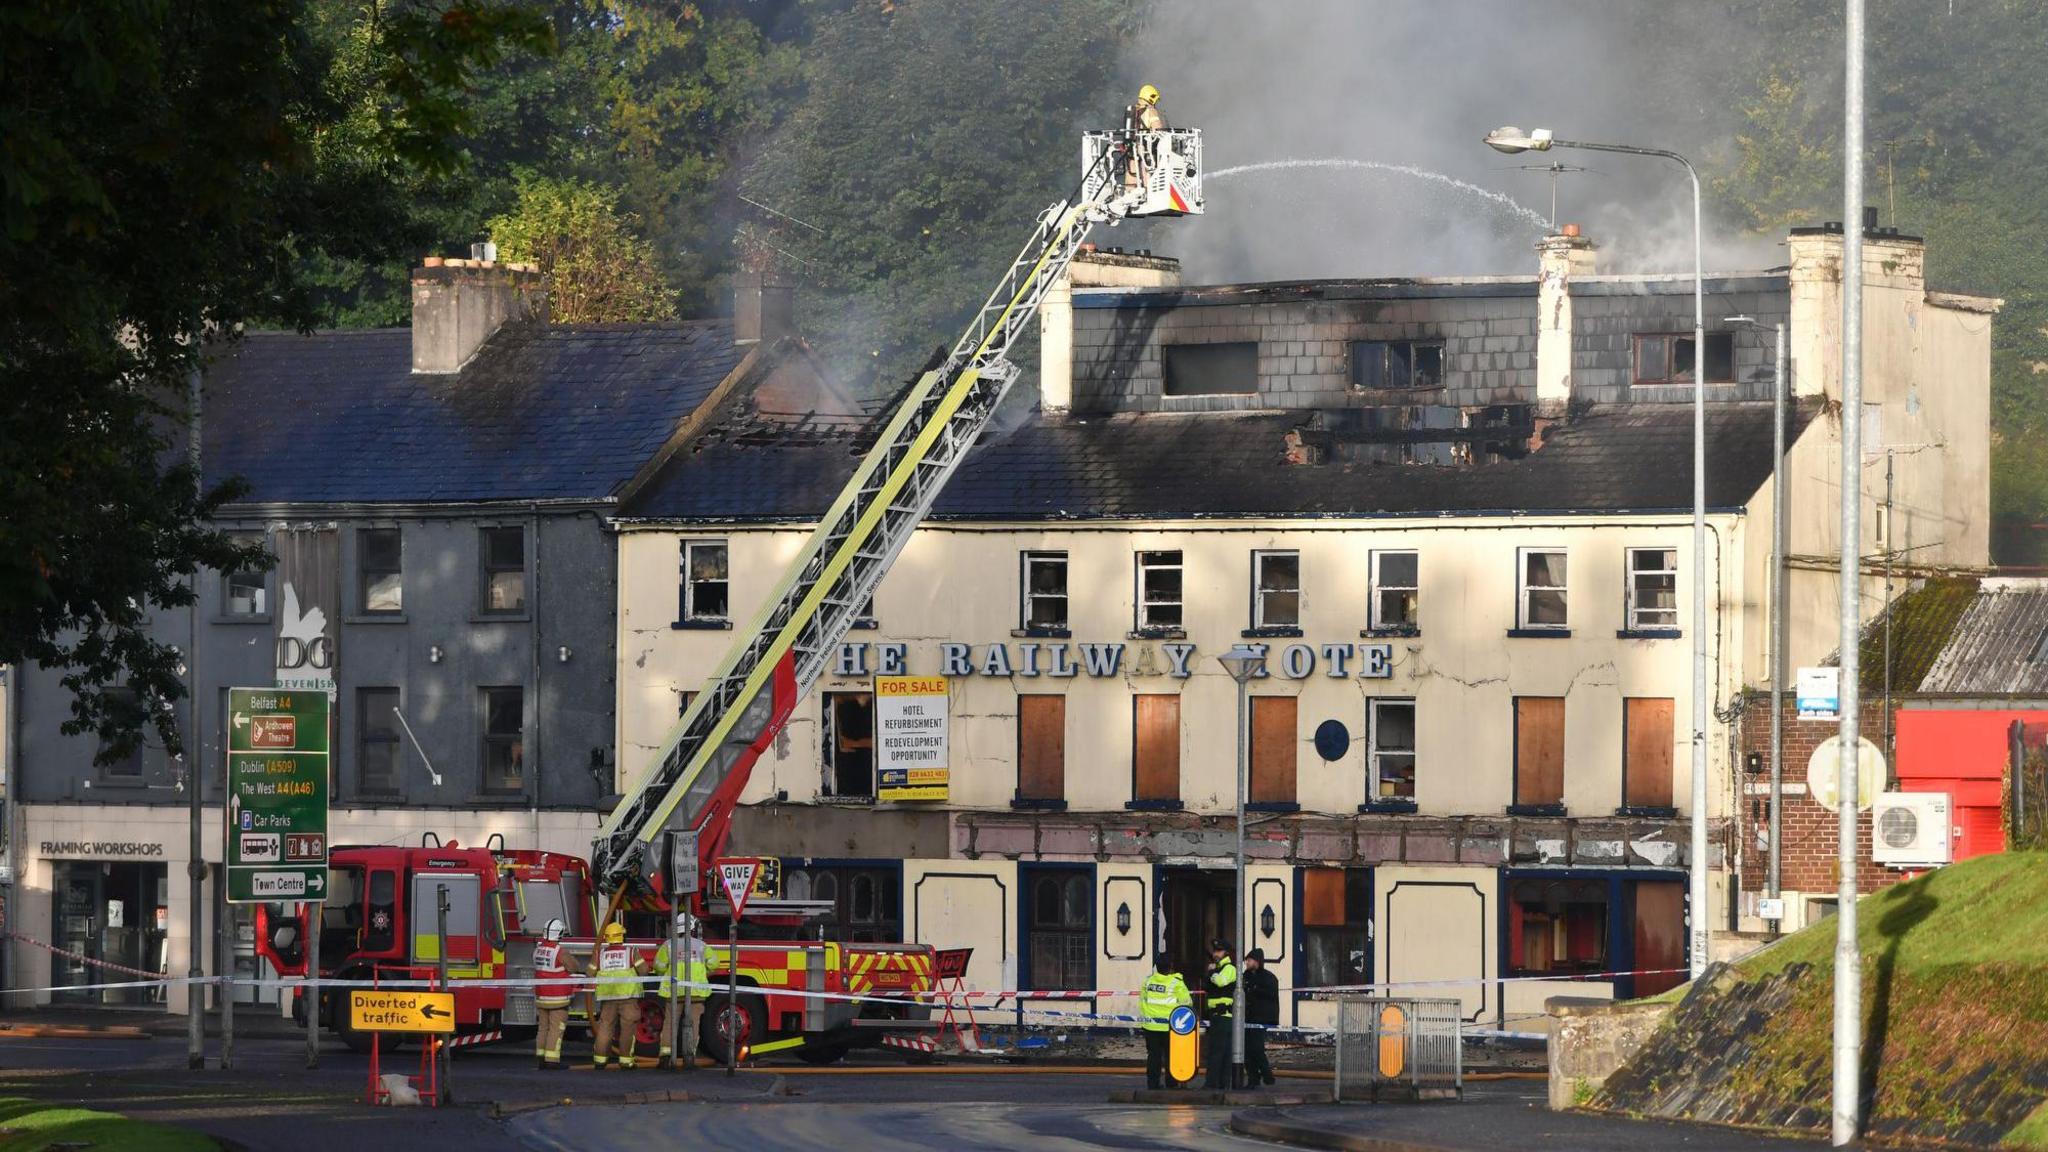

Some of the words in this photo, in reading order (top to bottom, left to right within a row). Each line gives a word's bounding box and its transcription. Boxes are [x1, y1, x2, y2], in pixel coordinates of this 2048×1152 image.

[800, 660, 821, 688] Northern
[820, 637, 838, 659] Ireland
[836, 624, 846, 638] Fire
[849, 594, 868, 618] Rescue
[276, 636, 334, 669] DG
[826, 643, 906, 677] HE
[882, 682, 907, 693] FOR
[911, 681, 944, 693] SALE
[251, 696, 277, 709] Belfast
[279, 697, 291, 709] A4
[902, 705, 924, 716] HOTEL
[885, 718, 943, 729] REFURBISHMENT
[268, 732, 290, 742] Theatre
[885, 736, 943, 748] REDEVELOPMENT
[891, 750, 938, 761] OPPORTUNITY
[240, 761, 265, 773] Dublin
[266, 760, 296, 775] (A509)
[241, 782, 254, 794] The
[257, 782, 276, 794] West
[254, 814, 268, 827] Car
[270, 814, 291, 827] Parks
[40, 841, 91, 855] FRAMING
[93, 842, 164, 856] WORKSHOPS
[428, 859, 456, 868] Emergency
[724, 866, 750, 879] GIVE
[255, 878, 276, 890] Town
[277, 877, 304, 890] Centre
[730, 882, 746, 890] WAY
[605, 952, 625, 960] FIRE
[354, 996, 417, 1009] Diverted
[363, 1012, 409, 1025] traffic
